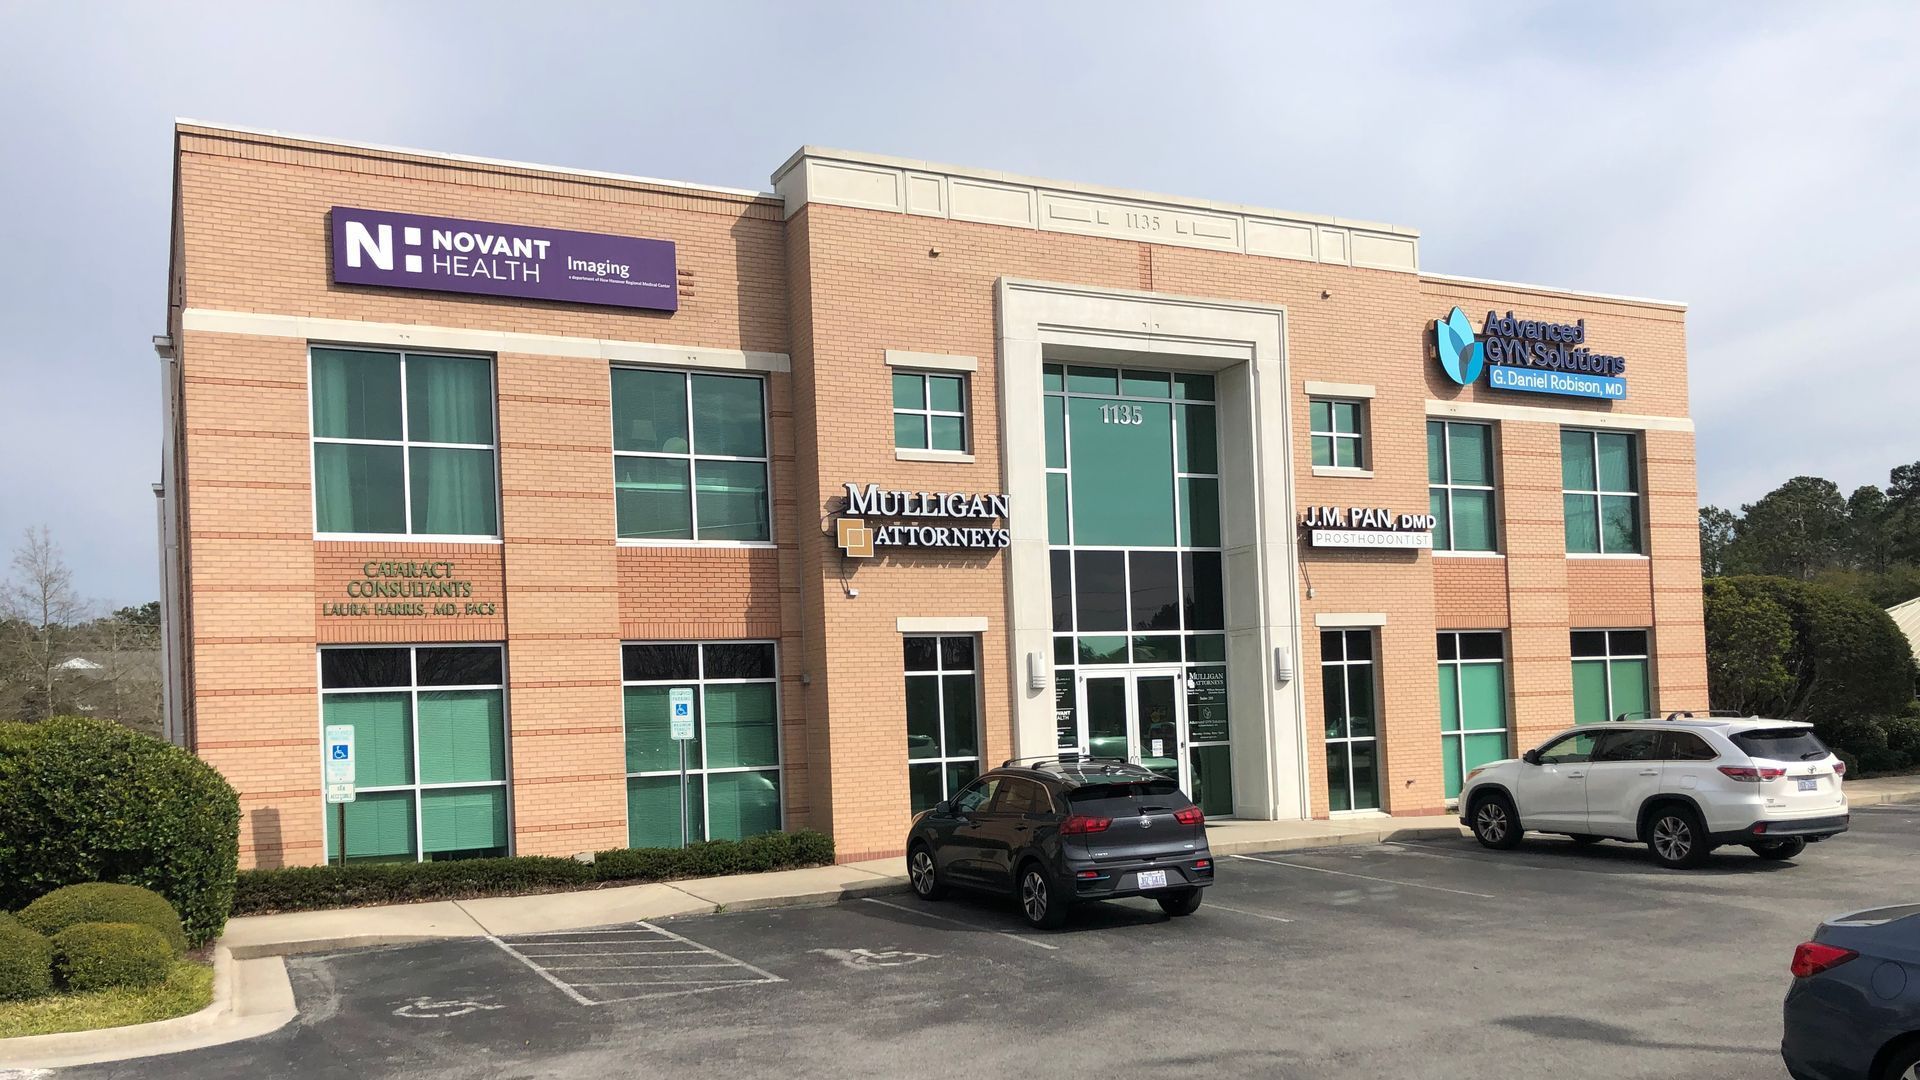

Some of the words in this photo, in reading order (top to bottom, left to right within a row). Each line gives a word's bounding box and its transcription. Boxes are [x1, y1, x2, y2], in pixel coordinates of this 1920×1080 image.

[1126, 213, 1160, 230] 1135
[432, 229, 551, 260] NOVANT
[433, 253, 541, 283] HEALTH
[568, 255, 630, 278] Imaging
[1484, 310, 1585, 344] Advanced
[1485, 336, 1530, 366] GYN
[1533, 342, 1626, 374] Solutions
[1493, 370, 1507, 385] G.
[1509, 370, 1548, 388] Daniel
[1552, 375, 1603, 396] Robison,
[1605, 382, 1623, 396] MD
[1099, 404, 1143, 425] 1135
[845, 483, 1011, 519] MULLIGAN
[1306, 506, 1346, 527] J.M.
[1351, 507, 1397, 531] PAN,
[1402, 515, 1436, 529] DMD
[874, 525, 1011, 548] ATTORNEYS
[1315, 532, 1429, 545] PROSTHODONTIST
[363, 561, 455, 579] CATARACT
[347, 580, 473, 598] CONSULTANTS
[323, 602, 369, 617] LAURA
[374, 602, 428, 618] HARRIS,
[433, 602, 461, 619] MD,
[465, 602, 496, 616] FACS
[1188, 672, 1224, 680] MULLIGAN
